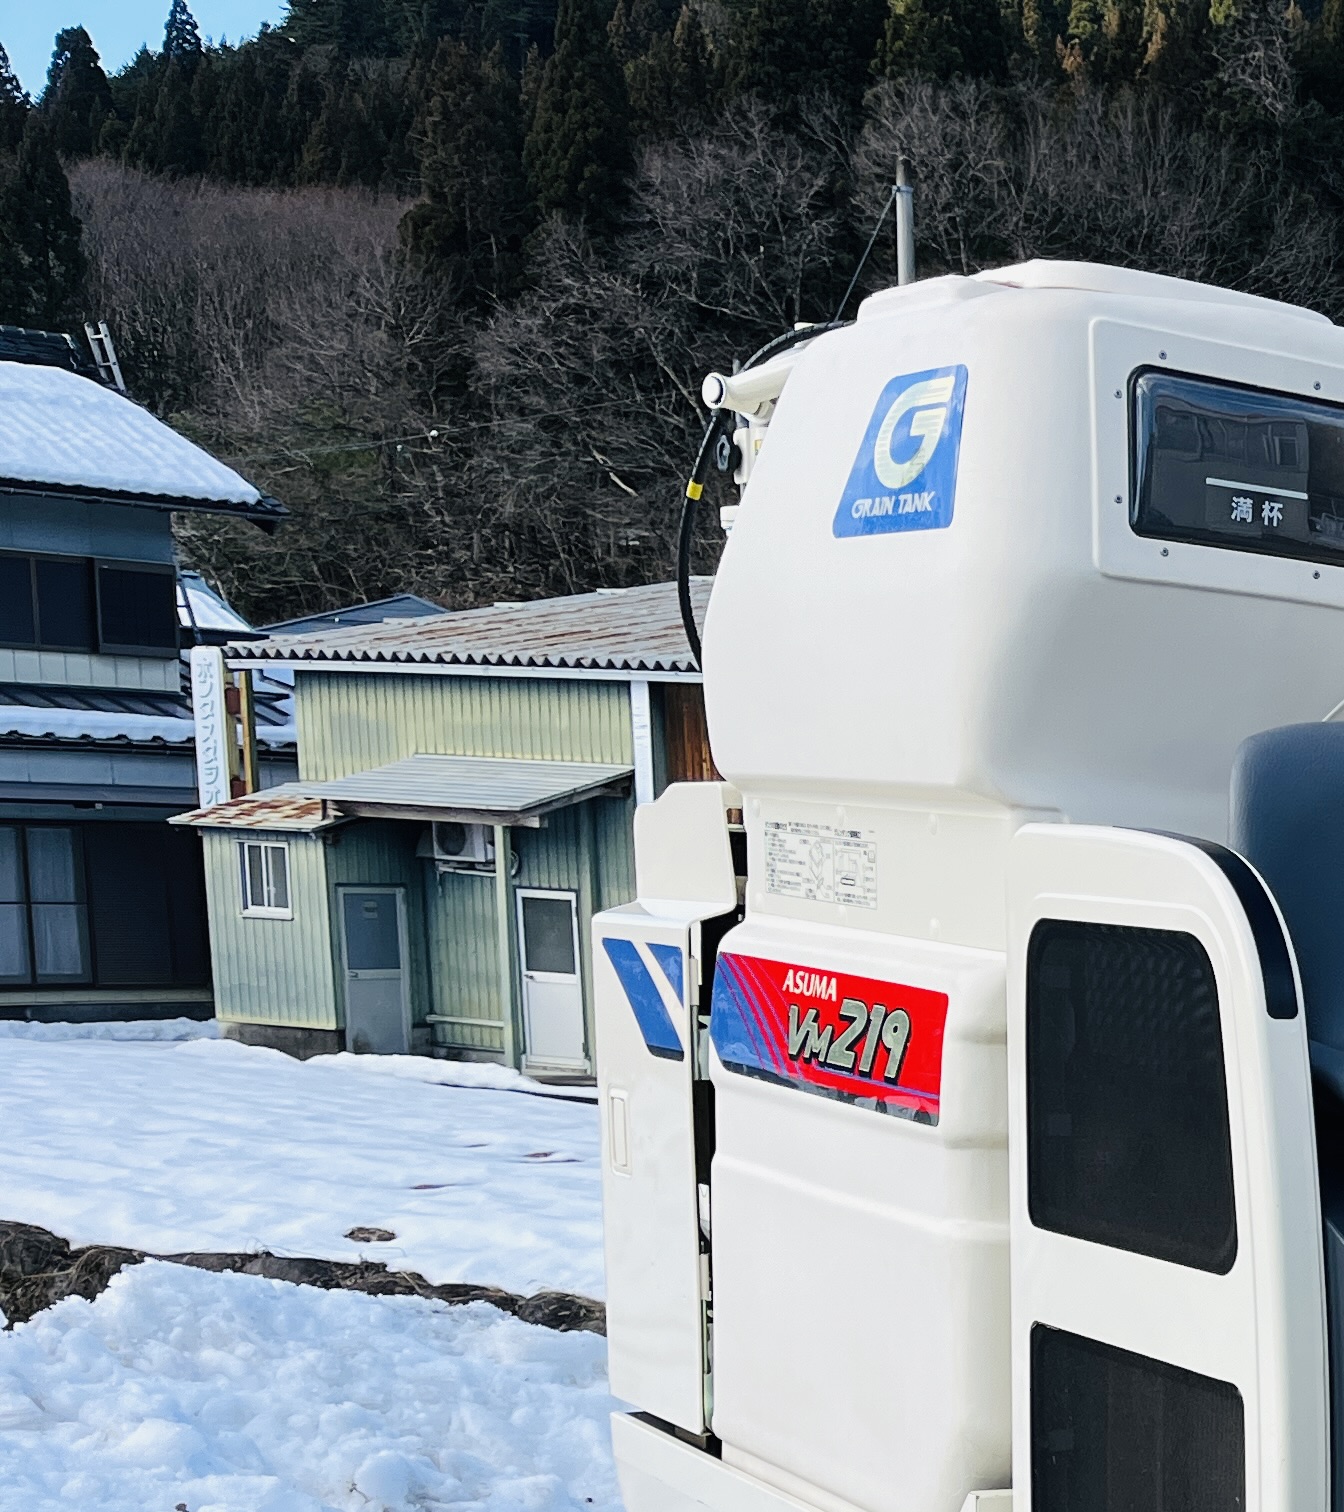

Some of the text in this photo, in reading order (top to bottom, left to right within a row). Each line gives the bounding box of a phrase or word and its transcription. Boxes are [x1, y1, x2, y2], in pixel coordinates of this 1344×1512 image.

[874, 375, 956, 489] G
[851, 491, 936, 519] GRAIN TANK
[1230, 496, 1284, 528] 満杯
[782, 969, 838, 1002] ASUMA
